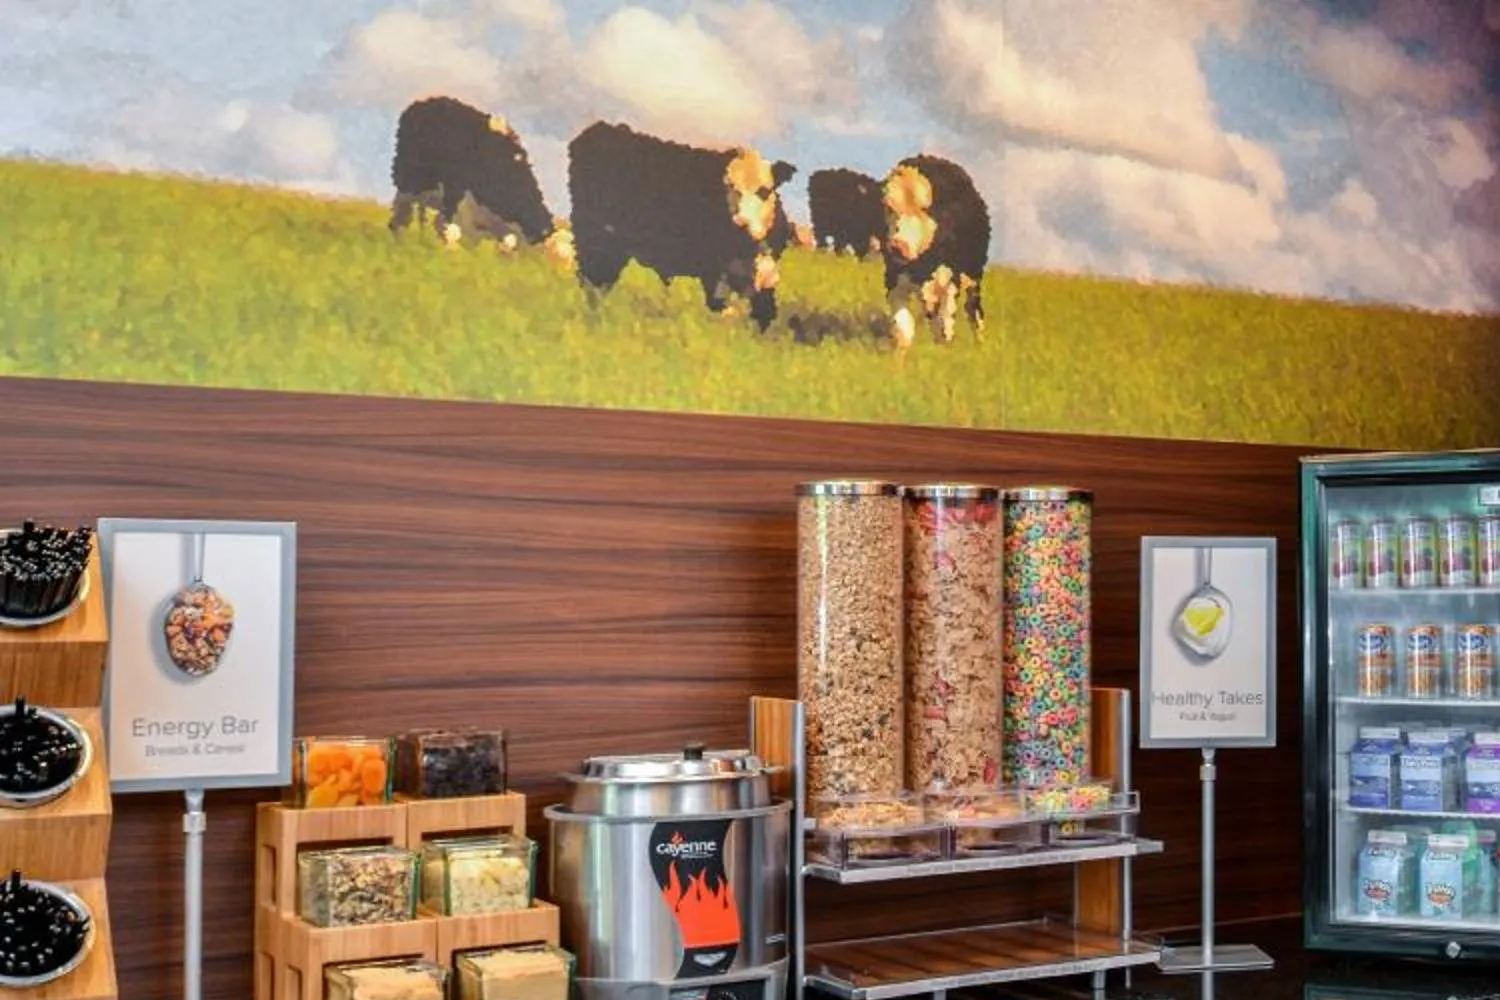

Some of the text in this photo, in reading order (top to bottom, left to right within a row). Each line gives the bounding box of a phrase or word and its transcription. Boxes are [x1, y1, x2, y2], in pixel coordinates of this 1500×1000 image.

[1151, 690, 1264, 709] Healthy Takes
[132, 715, 259, 739] Energy Bar
[656, 840, 718, 856] cayenne
